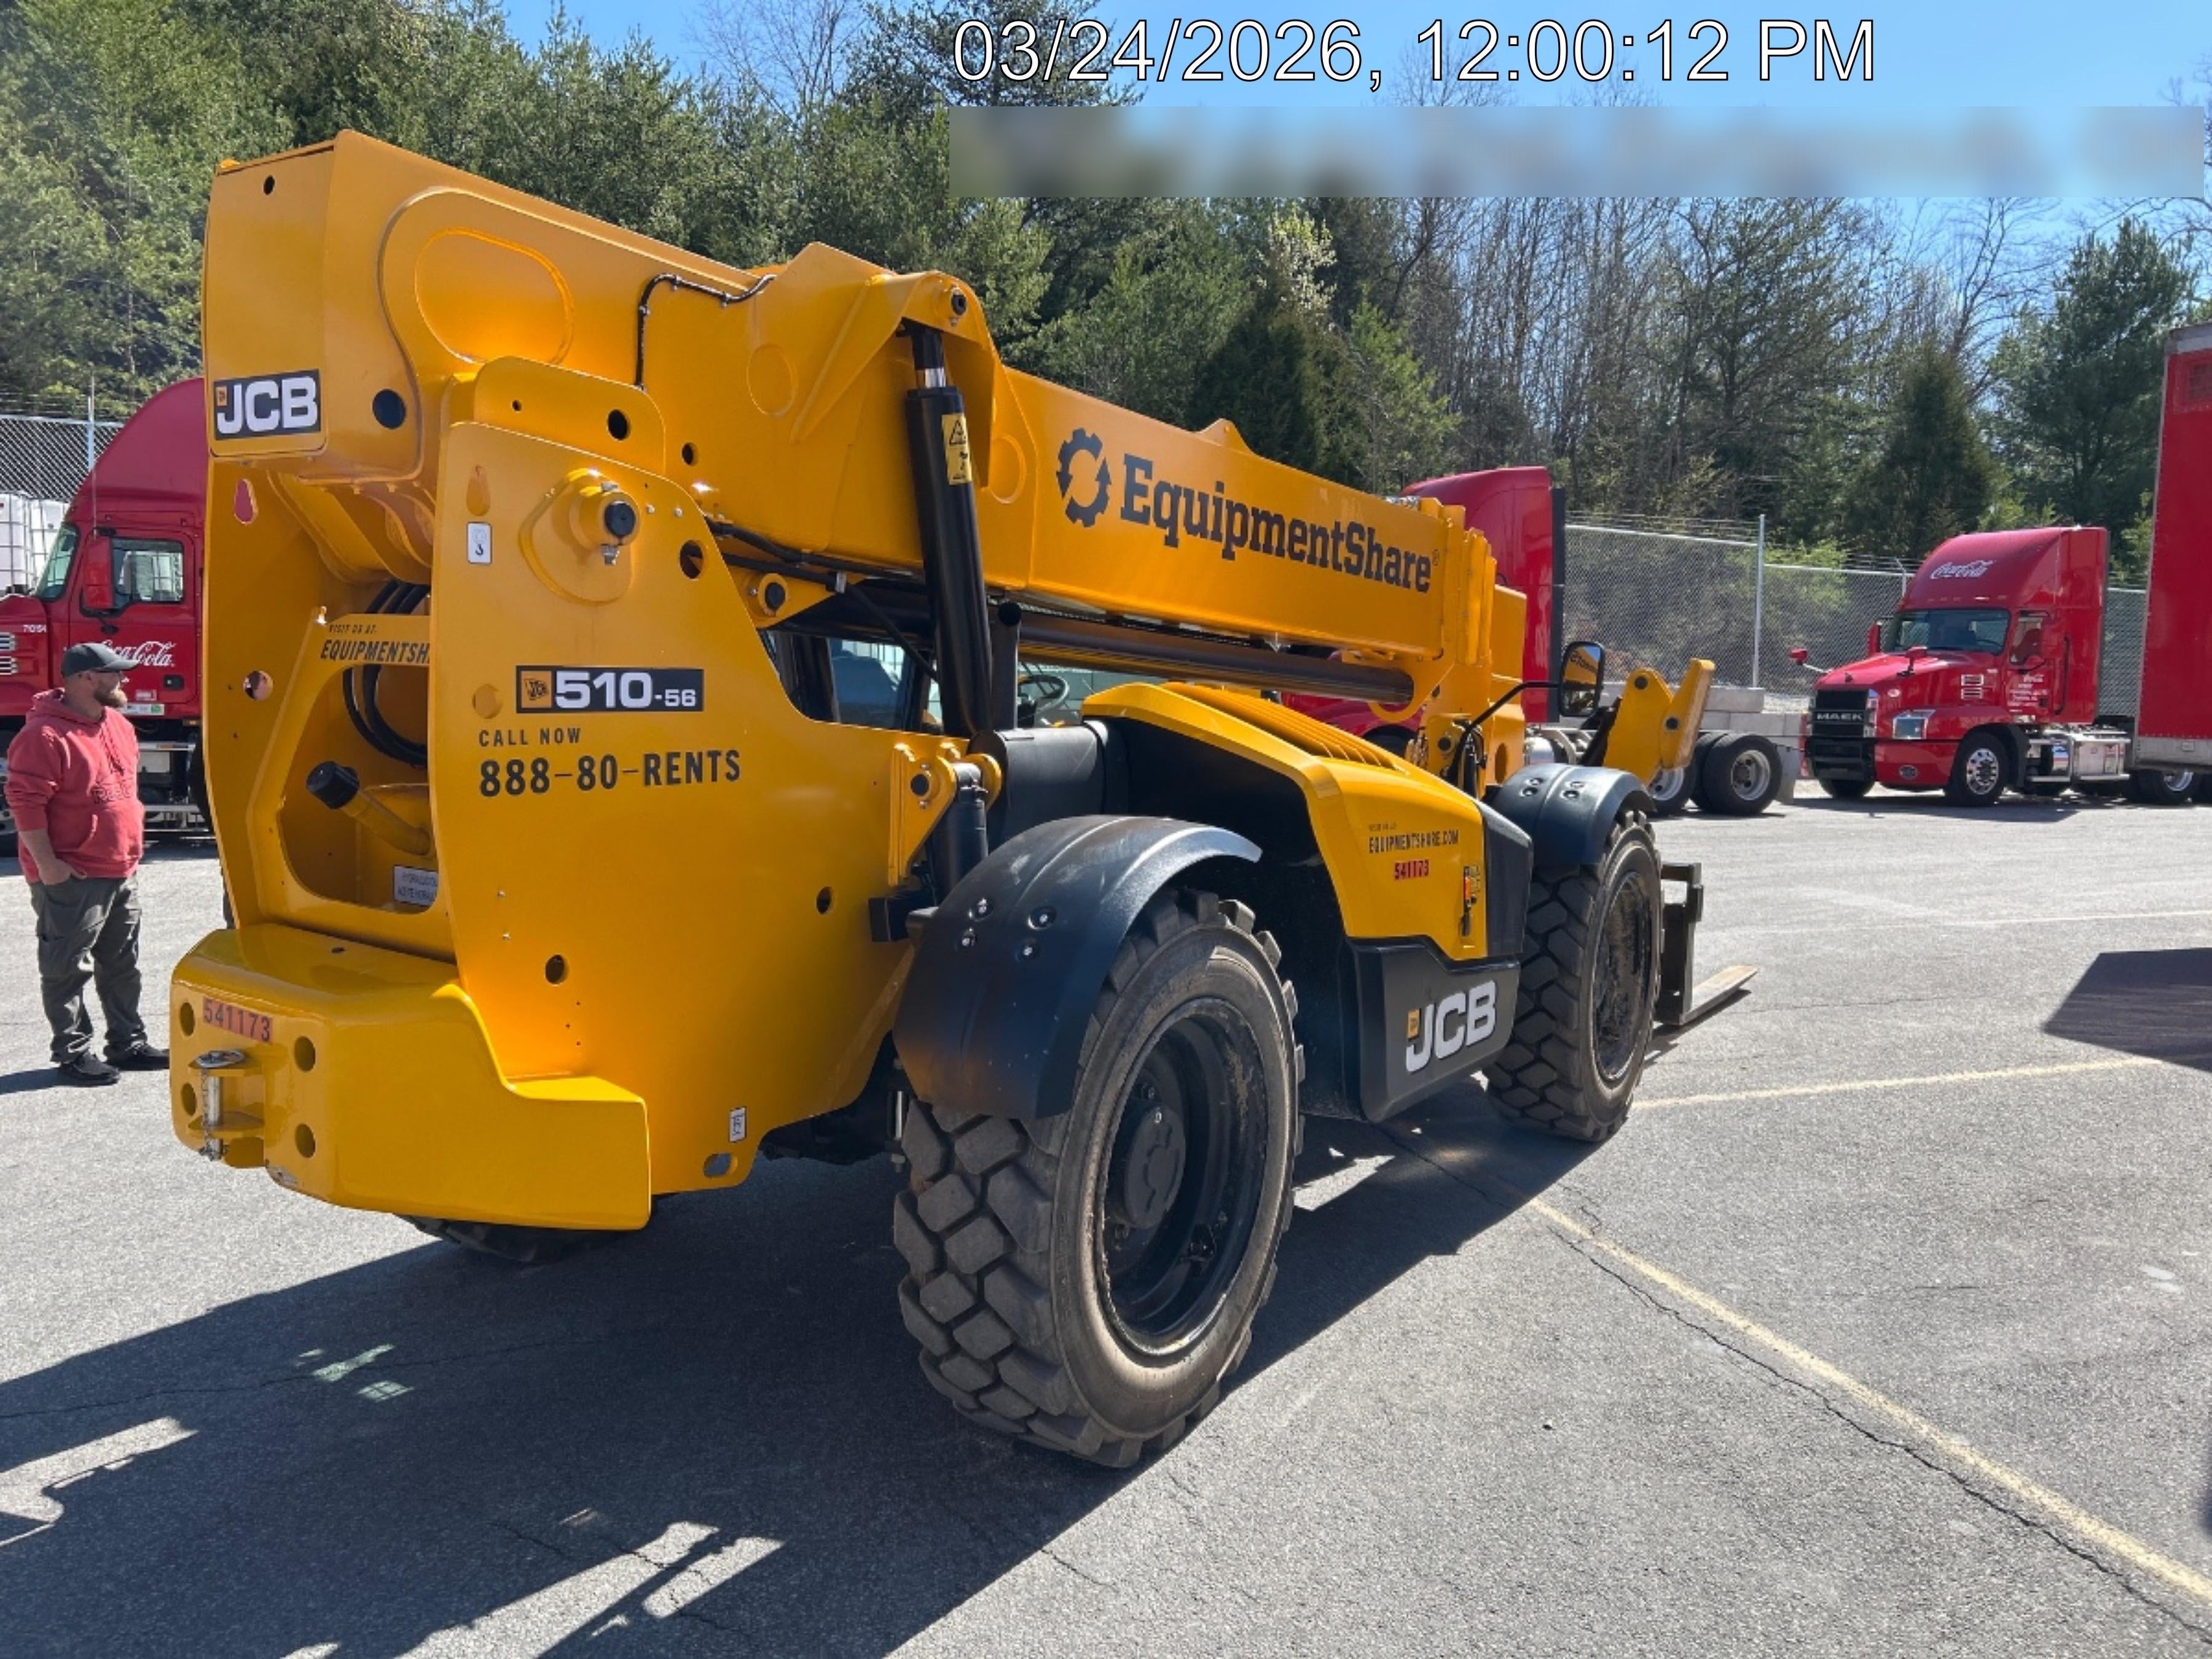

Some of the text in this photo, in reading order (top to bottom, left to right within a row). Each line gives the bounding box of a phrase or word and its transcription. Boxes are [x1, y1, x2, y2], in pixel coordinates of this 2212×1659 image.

[217, 377, 318, 434] JCB
[1120, 452, 1432, 594] EquipmentShare
[1931, 560, 1994, 579] Coca-Cola
[320, 639, 429, 664] EQUIPMENTSH
[555, 670, 696, 709] 510-56
[479, 728, 581, 747] CALL NOW
[480, 749, 741, 798] 888-80-RENTS
[1369, 830, 1459, 853] EQUIPMENTSHARE.COM
[1394, 858, 1429, 880] 541173
[203, 997, 271, 1043] 541173
[1406, 980, 1496, 1072] JCB
